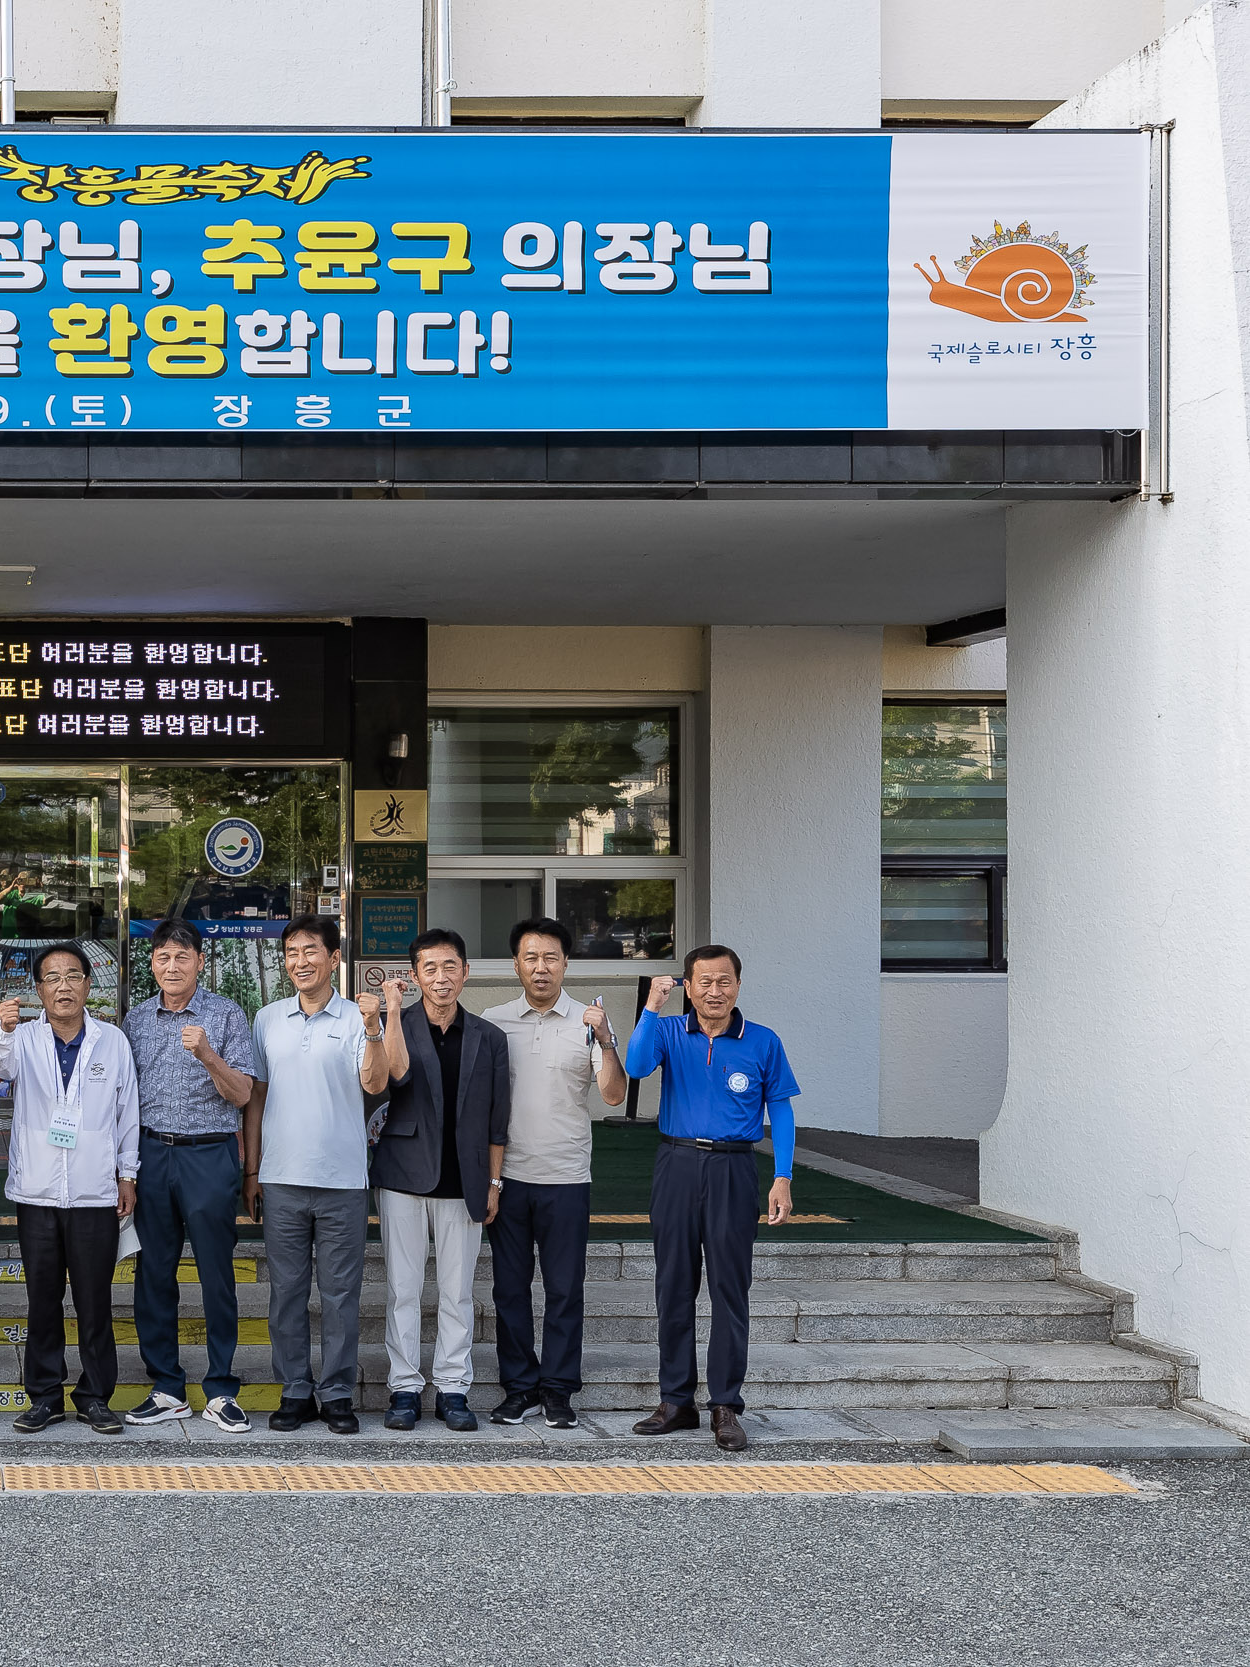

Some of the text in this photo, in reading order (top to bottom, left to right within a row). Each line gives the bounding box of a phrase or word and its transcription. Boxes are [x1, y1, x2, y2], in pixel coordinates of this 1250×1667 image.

[200, 217, 474, 292] 추윤구
[501, 220, 772, 293] 의장님
[49, 302, 513, 377] 환영합니다!
[927, 332, 1098, 364] 국제슬로시티 장흥
[41, 642, 134, 664] 여러분을
[143, 642, 268, 666] 환영합니다.
[53, 678, 146, 700] 여러분을
[155, 678, 280, 702] 환영합니다.
[37, 714, 131, 736] 여러분을
[139, 714, 265, 738] 환영합니다.
[387, 969, 409, 979] 금연구
